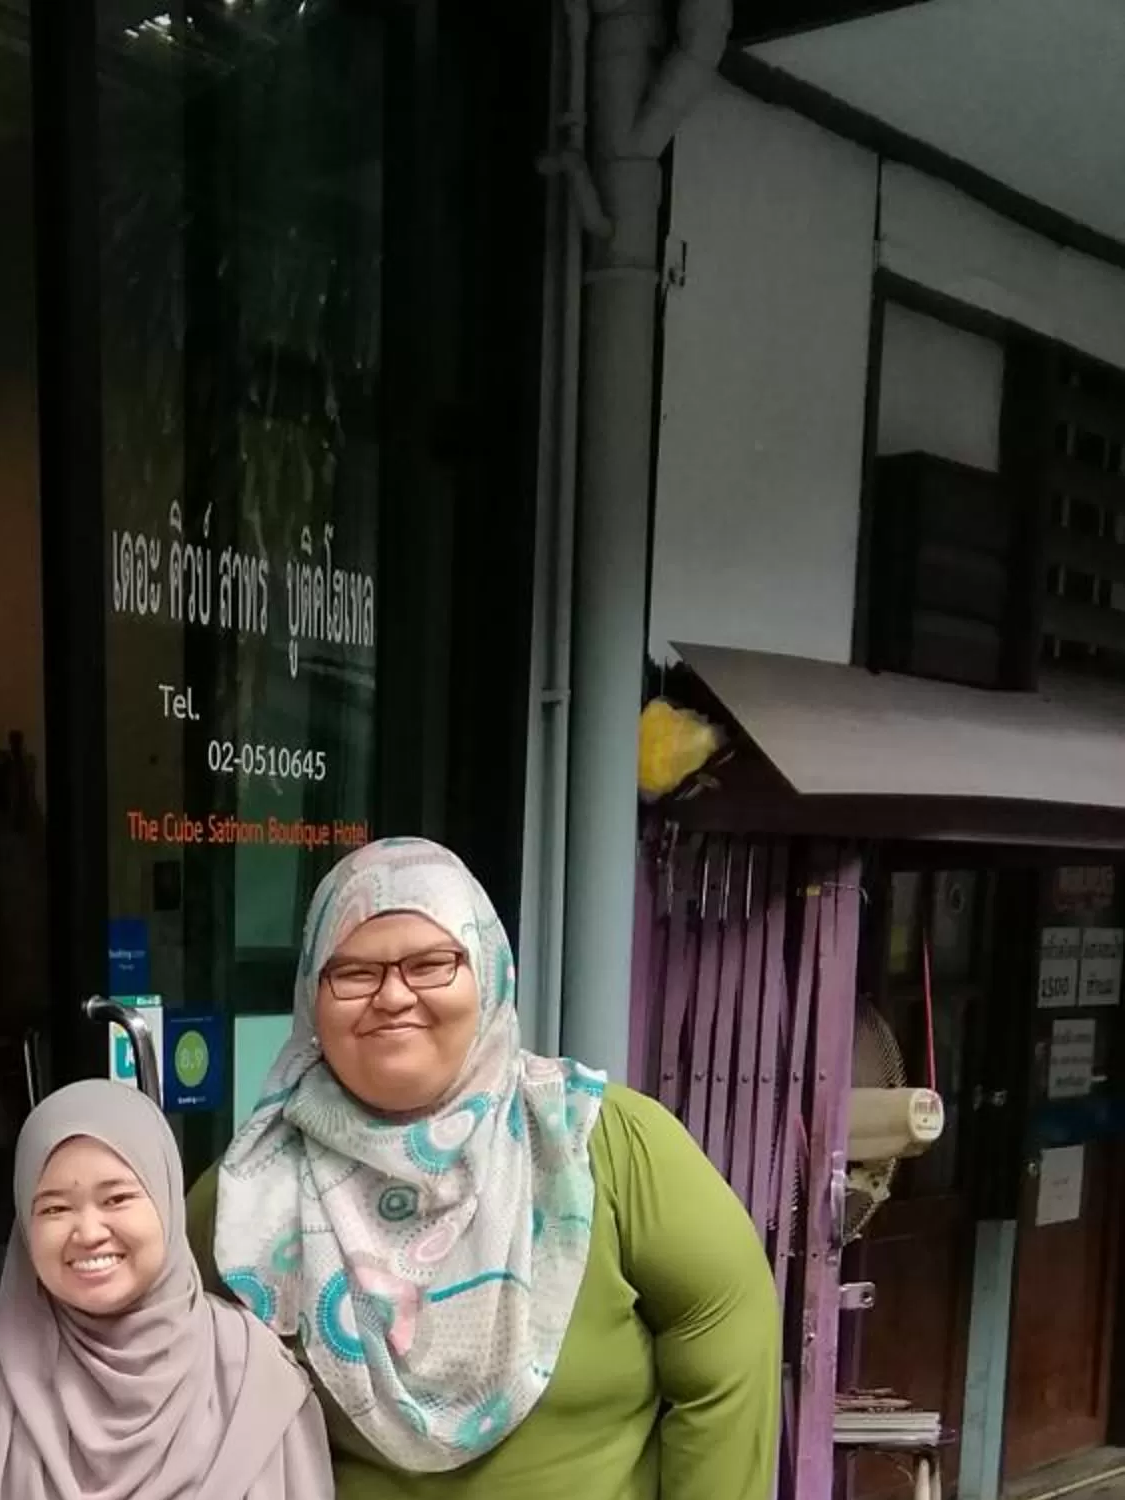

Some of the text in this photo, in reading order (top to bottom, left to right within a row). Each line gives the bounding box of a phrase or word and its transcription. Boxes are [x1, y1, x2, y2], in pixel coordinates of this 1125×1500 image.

[112, 529, 161, 616] เดอะ
[219, 545, 269, 636] สาทร
[158, 684, 200, 721] Tel.
[207, 739, 327, 781] 02-0510645
[127, 811, 369, 852] The Cube Sathorn Boutique Hotel
